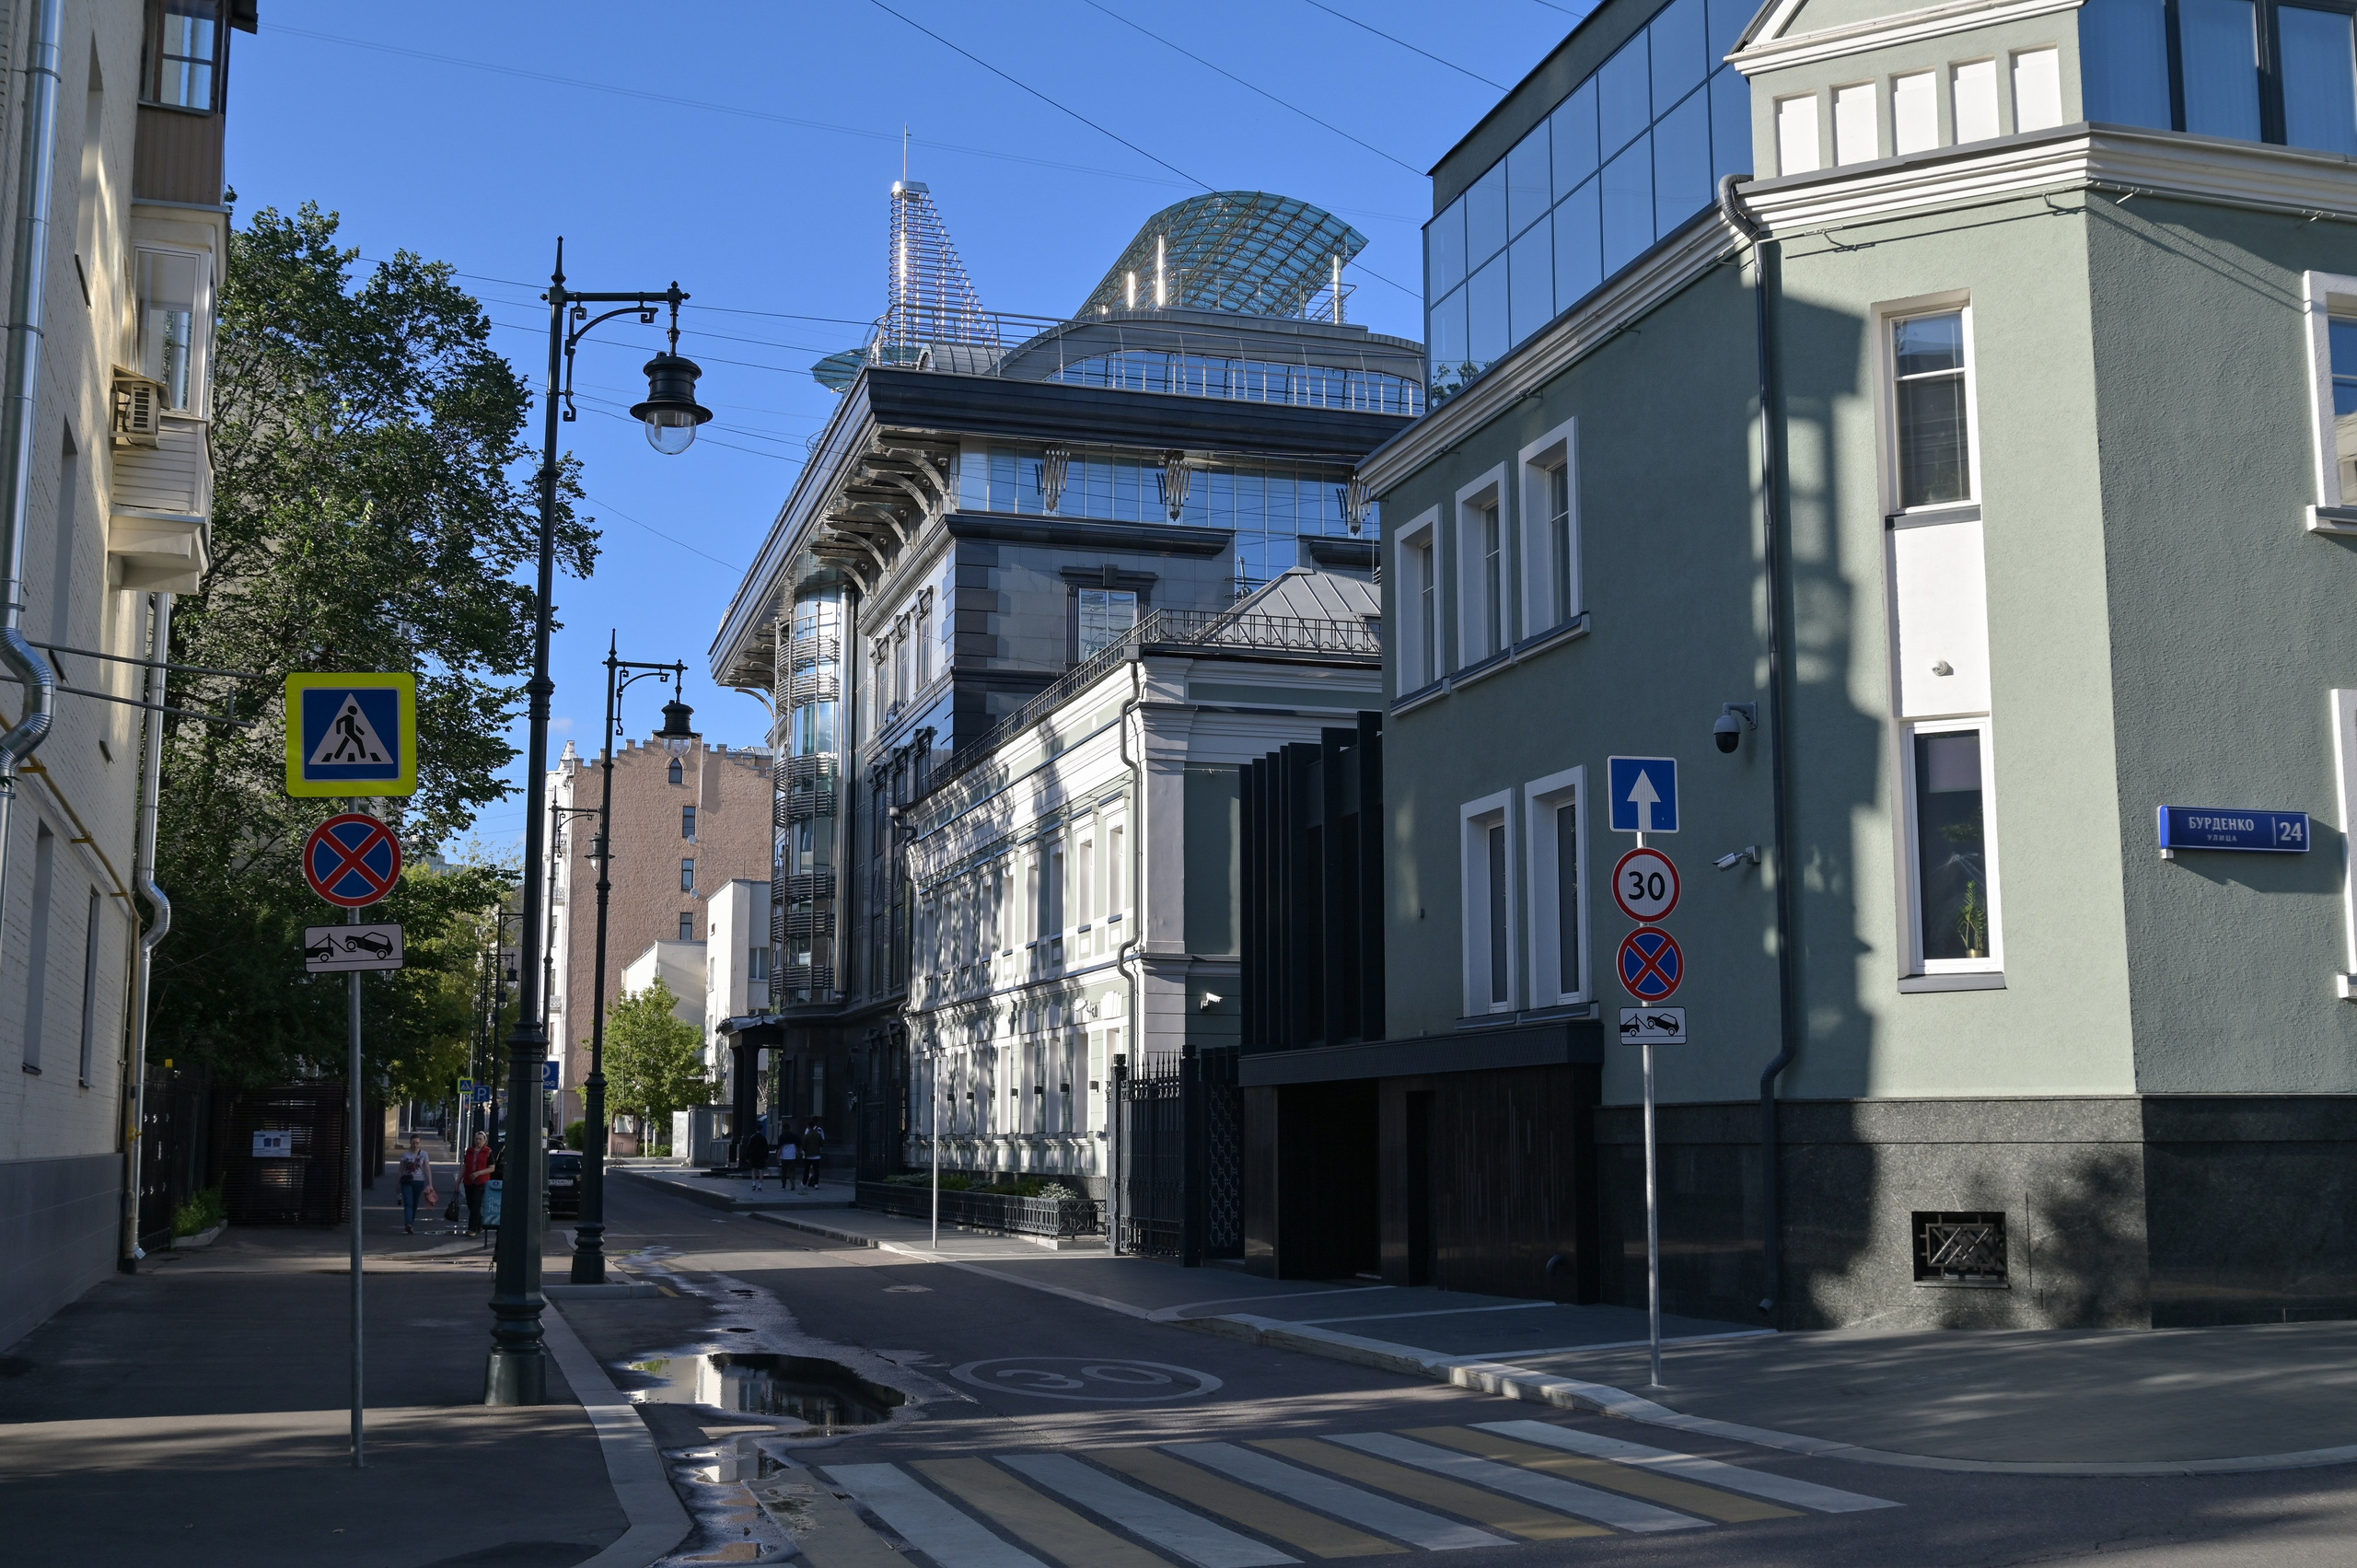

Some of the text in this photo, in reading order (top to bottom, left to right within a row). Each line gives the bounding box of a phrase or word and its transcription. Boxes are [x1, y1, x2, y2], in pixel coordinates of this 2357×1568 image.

[2188, 816, 2255, 831] БУРДЕНКО
[2279, 821, 2304, 842] 24
[2206, 834, 2238, 842] УЛИЦА
[1628, 870, 1666, 901] 30
[477, 1087, 487, 1101] P
[996, 1365, 1172, 1389] 30
